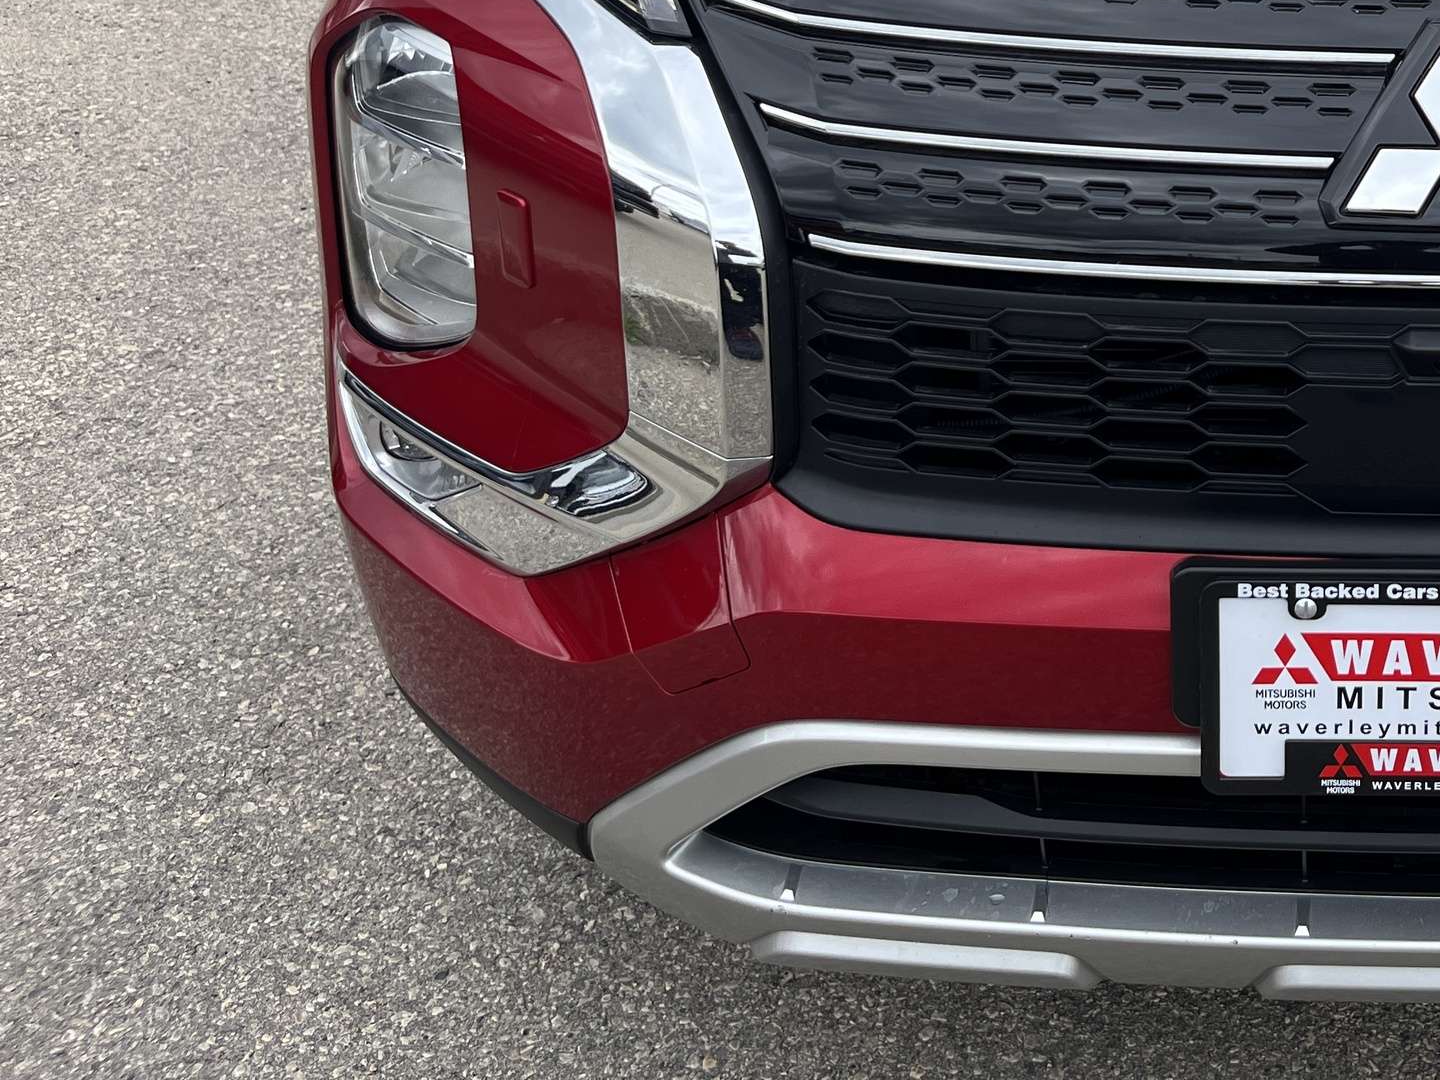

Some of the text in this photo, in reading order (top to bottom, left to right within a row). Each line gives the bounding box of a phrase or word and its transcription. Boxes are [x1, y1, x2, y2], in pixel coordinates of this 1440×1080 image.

[1237, 583, 1439, 600] Best Backed Cars
[1255, 688, 1316, 698] MITSUBISHI
[1264, 700, 1307, 710] MOTORS
[1321, 778, 1361, 787] MITSUBISHI
[1326, 786, 1355, 794] MOTORS
